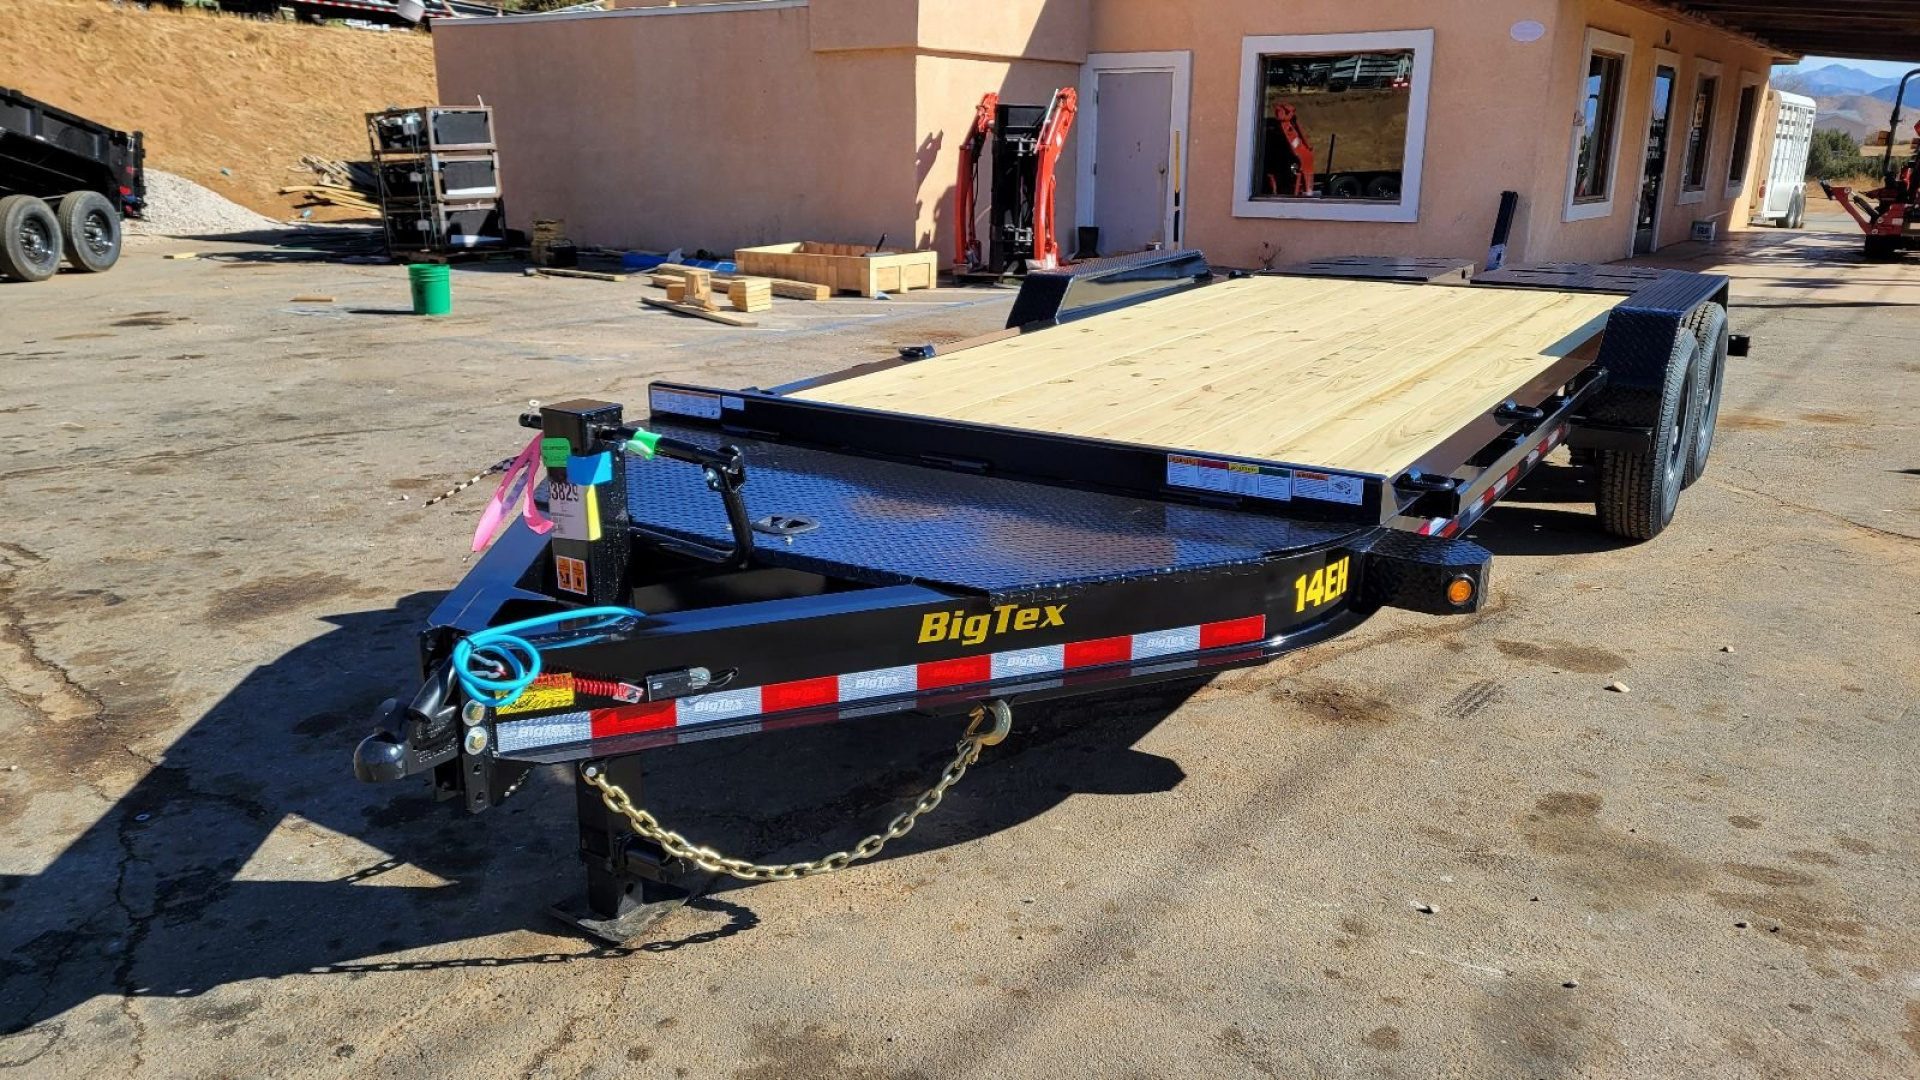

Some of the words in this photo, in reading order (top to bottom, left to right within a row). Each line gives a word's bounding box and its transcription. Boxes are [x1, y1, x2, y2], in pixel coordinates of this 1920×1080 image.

[1295, 556, 1350, 613] 14EH
[918, 604, 1067, 646] BigTex
[1006, 653, 1049, 667] BigTex
[855, 675, 900, 690] BigTex
[694, 698, 744, 713] BigTex
